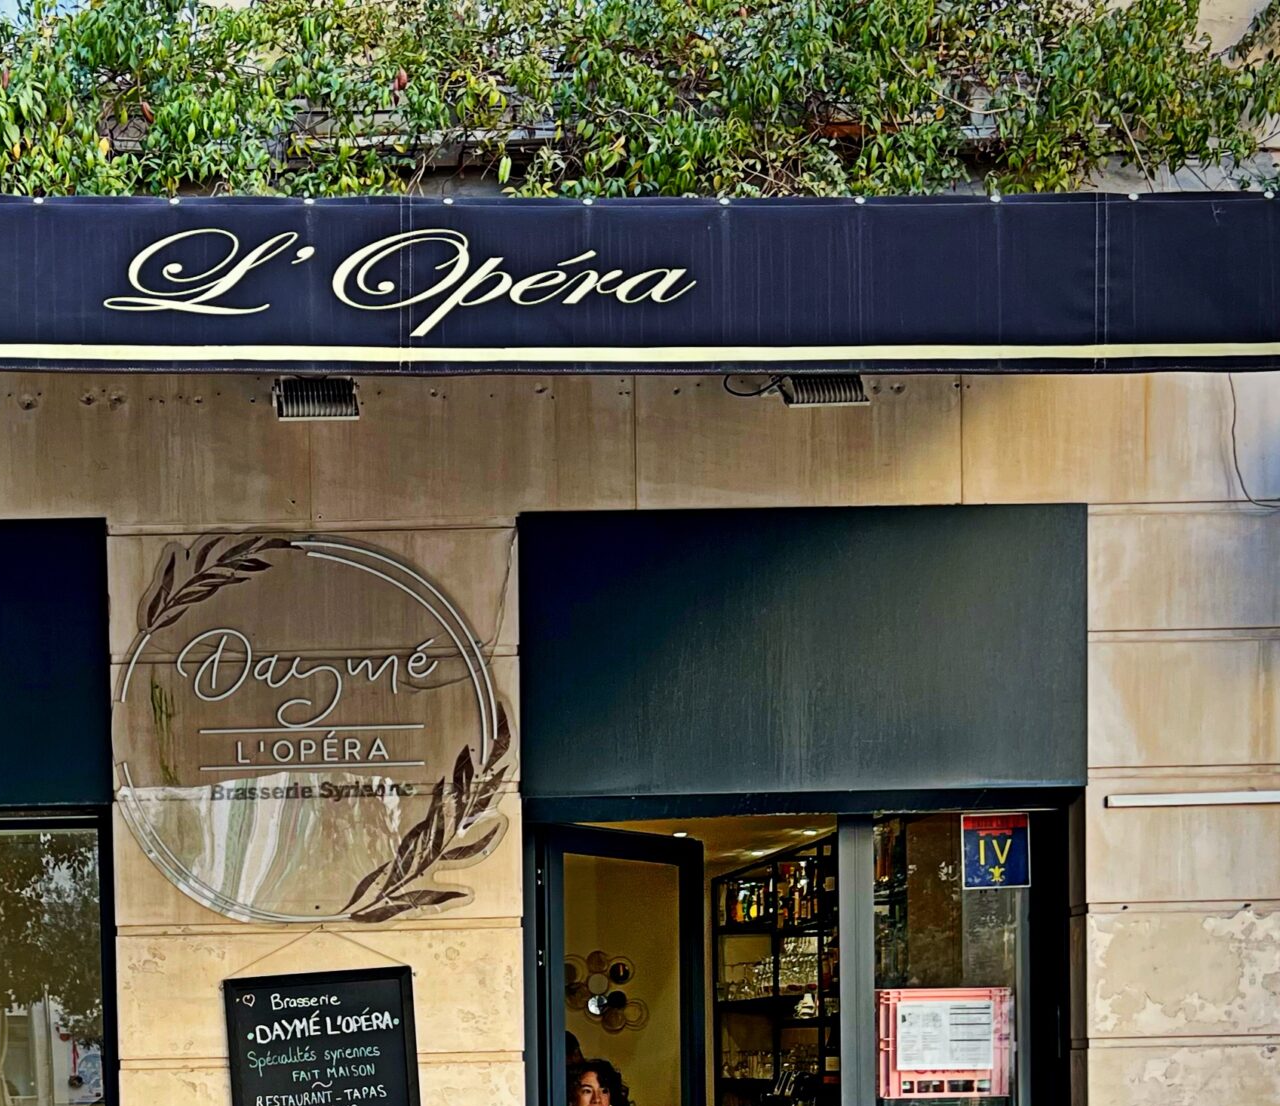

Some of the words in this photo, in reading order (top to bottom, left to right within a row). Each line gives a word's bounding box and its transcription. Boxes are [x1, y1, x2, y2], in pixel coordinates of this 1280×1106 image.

[176, 628, 440, 729] Daymé
[236, 730, 390, 764] L'OPÉRA
[211, 782, 313, 801] Brasserie
[979, 838, 1012, 866] IV
[270, 992, 342, 1011] Brasserie
[255, 1010, 321, 1044] DAYMÉ
[326, 1007, 394, 1035] L'OPÉRA
[247, 1046, 317, 1077] Spécialités
[324, 1046, 381, 1066] syriennes
[326, 1063, 376, 1078] MAISON
[344, 1084, 388, 1101] TAPAS
